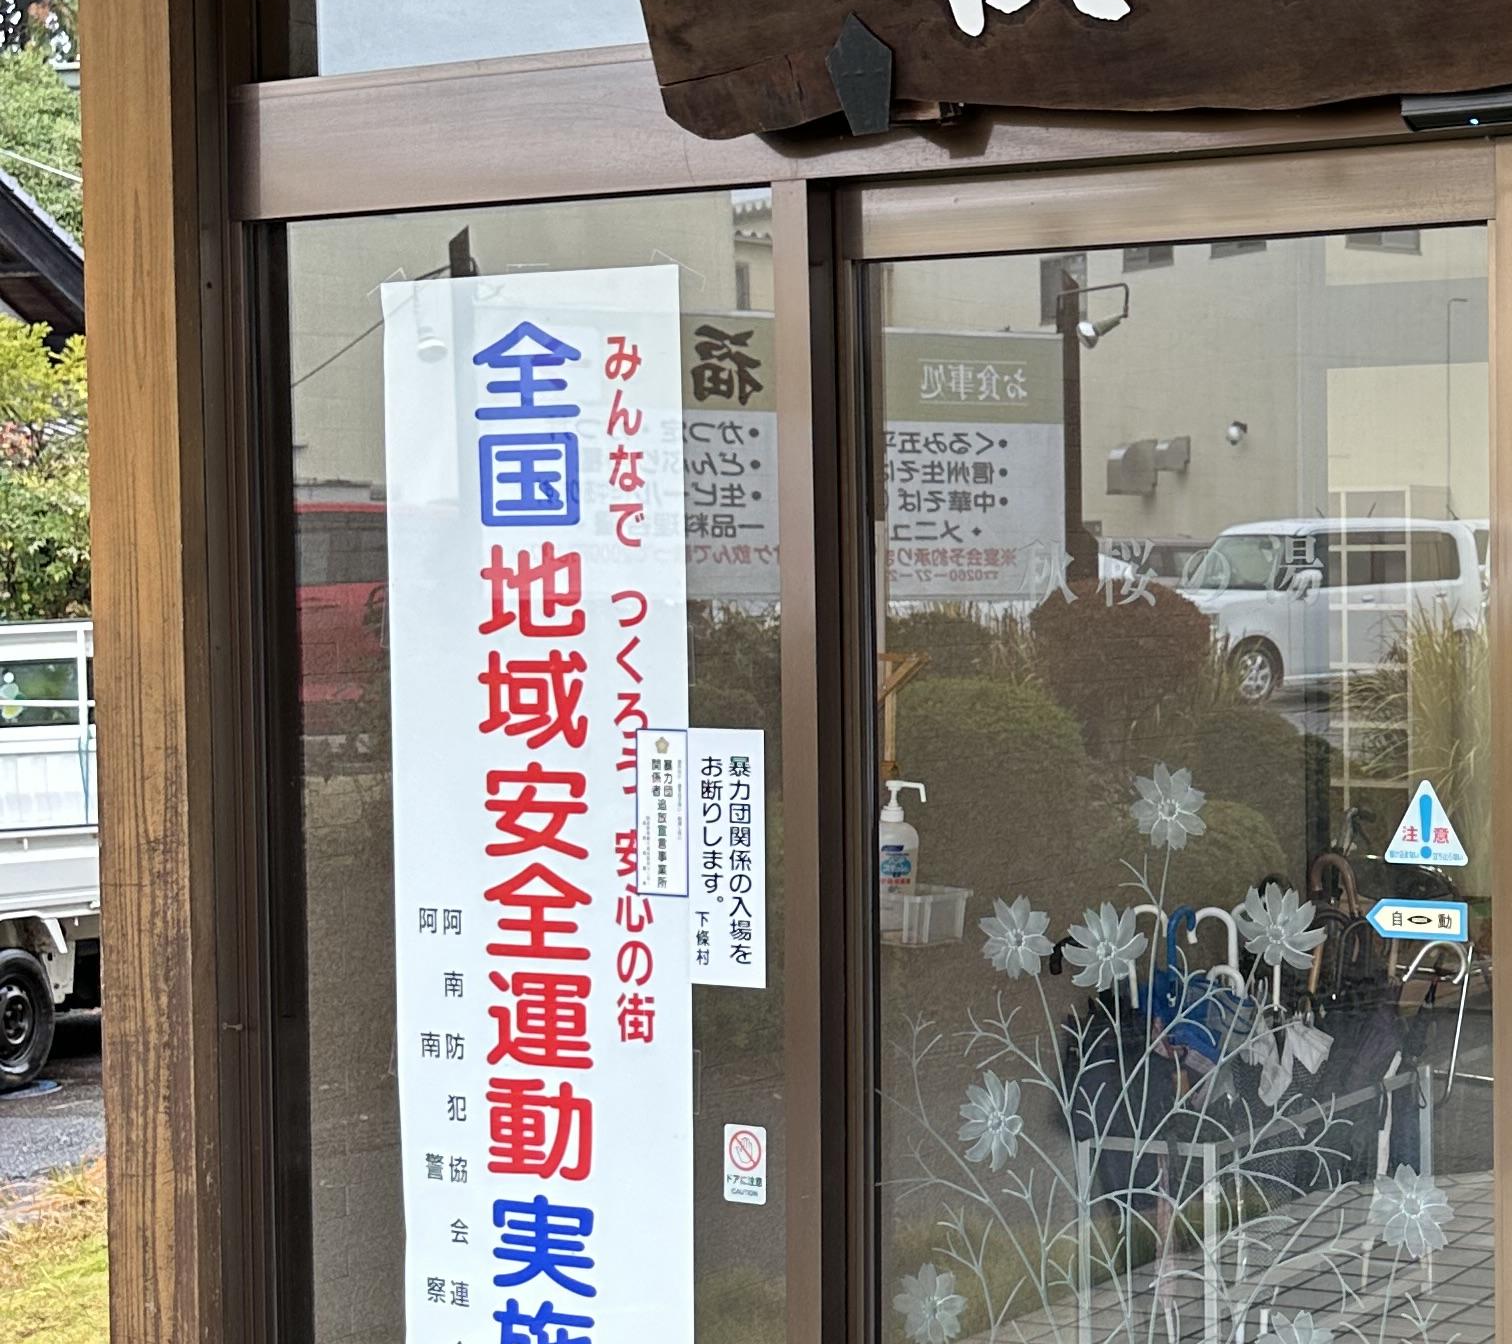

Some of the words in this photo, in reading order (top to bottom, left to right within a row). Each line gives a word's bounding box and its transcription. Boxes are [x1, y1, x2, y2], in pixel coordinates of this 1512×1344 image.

[604, 336, 646, 547] みんなで
[700, 755, 724, 904] お断りします。
[728, 755, 753, 965] 暴力団関係の入場を
[1402, 825, 1450, 844] 注意
[1392, 910, 1453, 929] 自動
